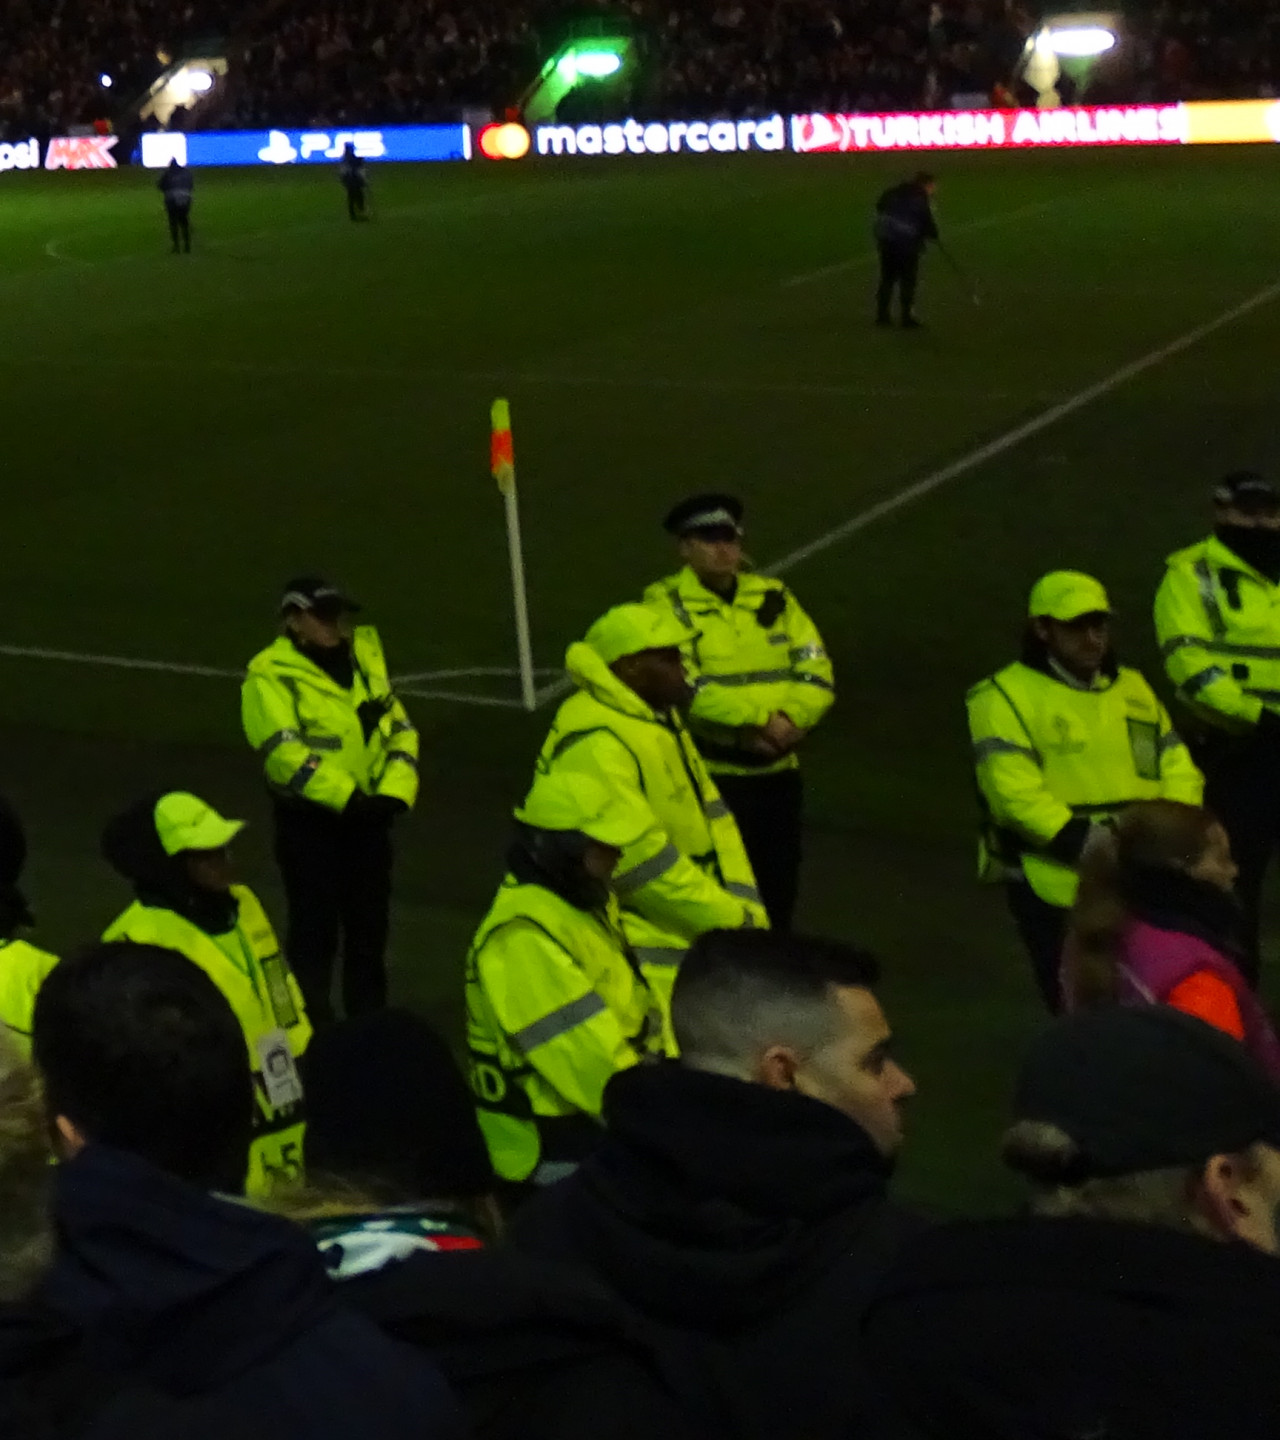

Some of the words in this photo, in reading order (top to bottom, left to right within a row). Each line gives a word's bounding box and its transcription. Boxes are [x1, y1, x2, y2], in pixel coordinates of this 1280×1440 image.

[299, 131, 386, 159] PS5
[537, 114, 784, 155] mastercard
[849, 111, 1002, 149] TURKISH
[1011, 104, 1182, 144] AIRLINES
